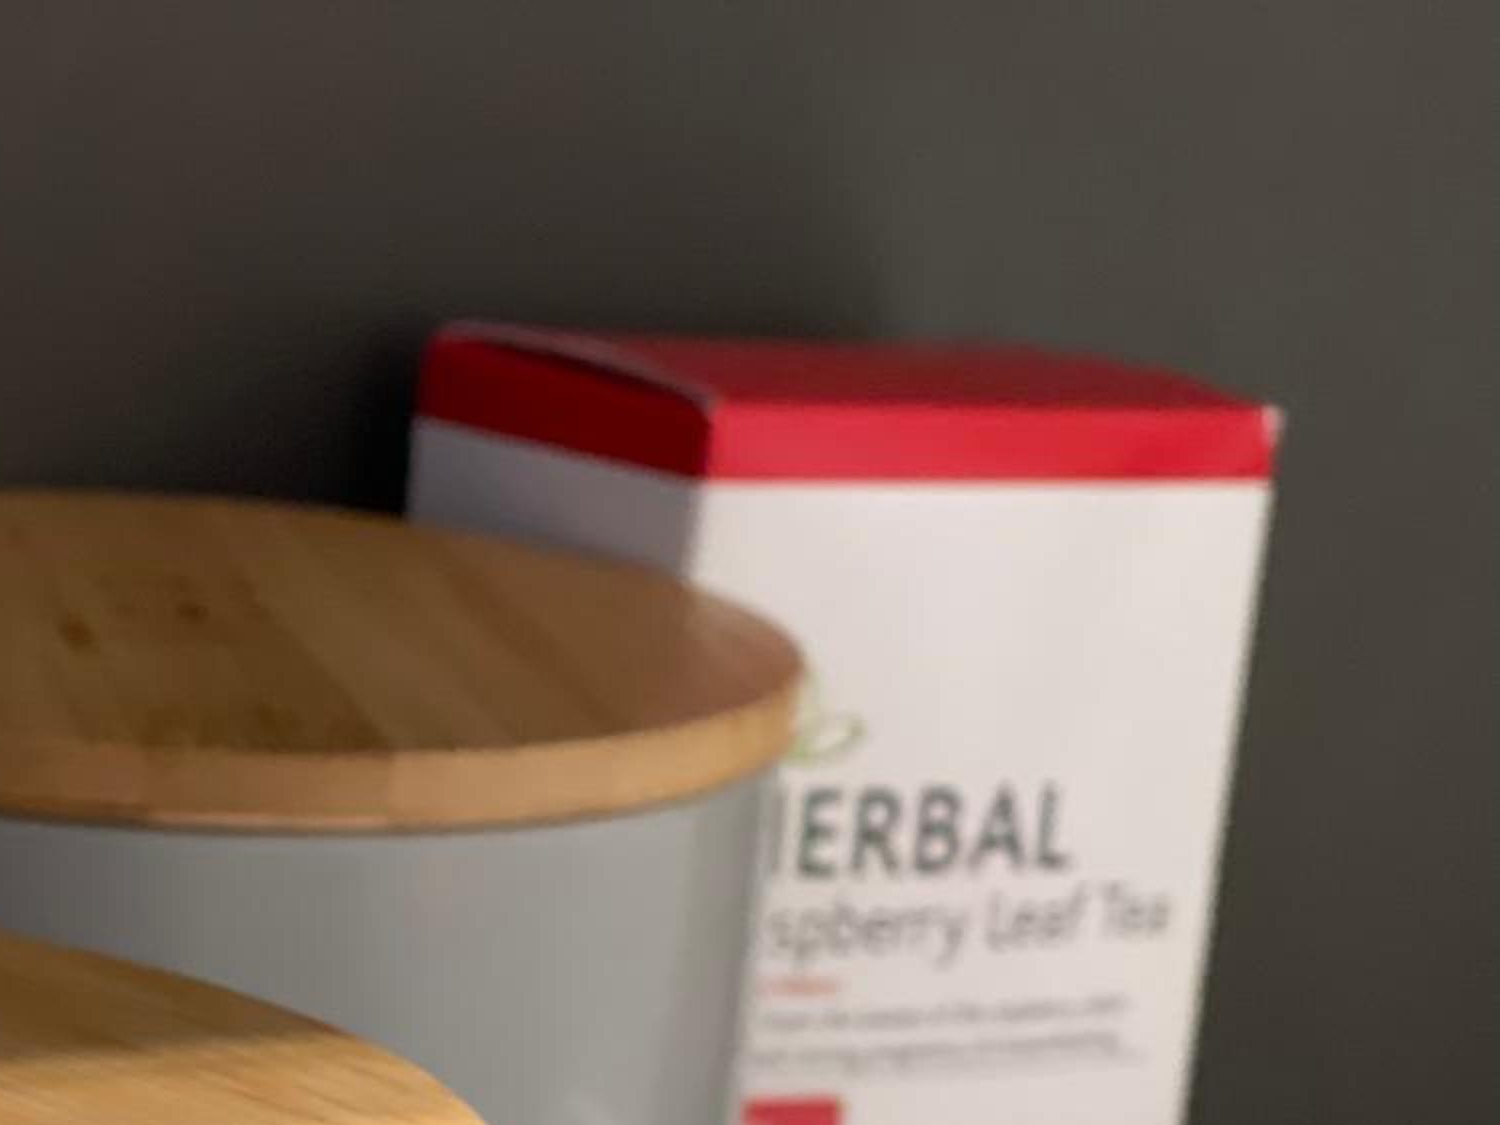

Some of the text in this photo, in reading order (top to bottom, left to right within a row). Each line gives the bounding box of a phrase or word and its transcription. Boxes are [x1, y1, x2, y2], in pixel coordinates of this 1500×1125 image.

[763, 880, 1171, 970] spberry Leaf Tea
